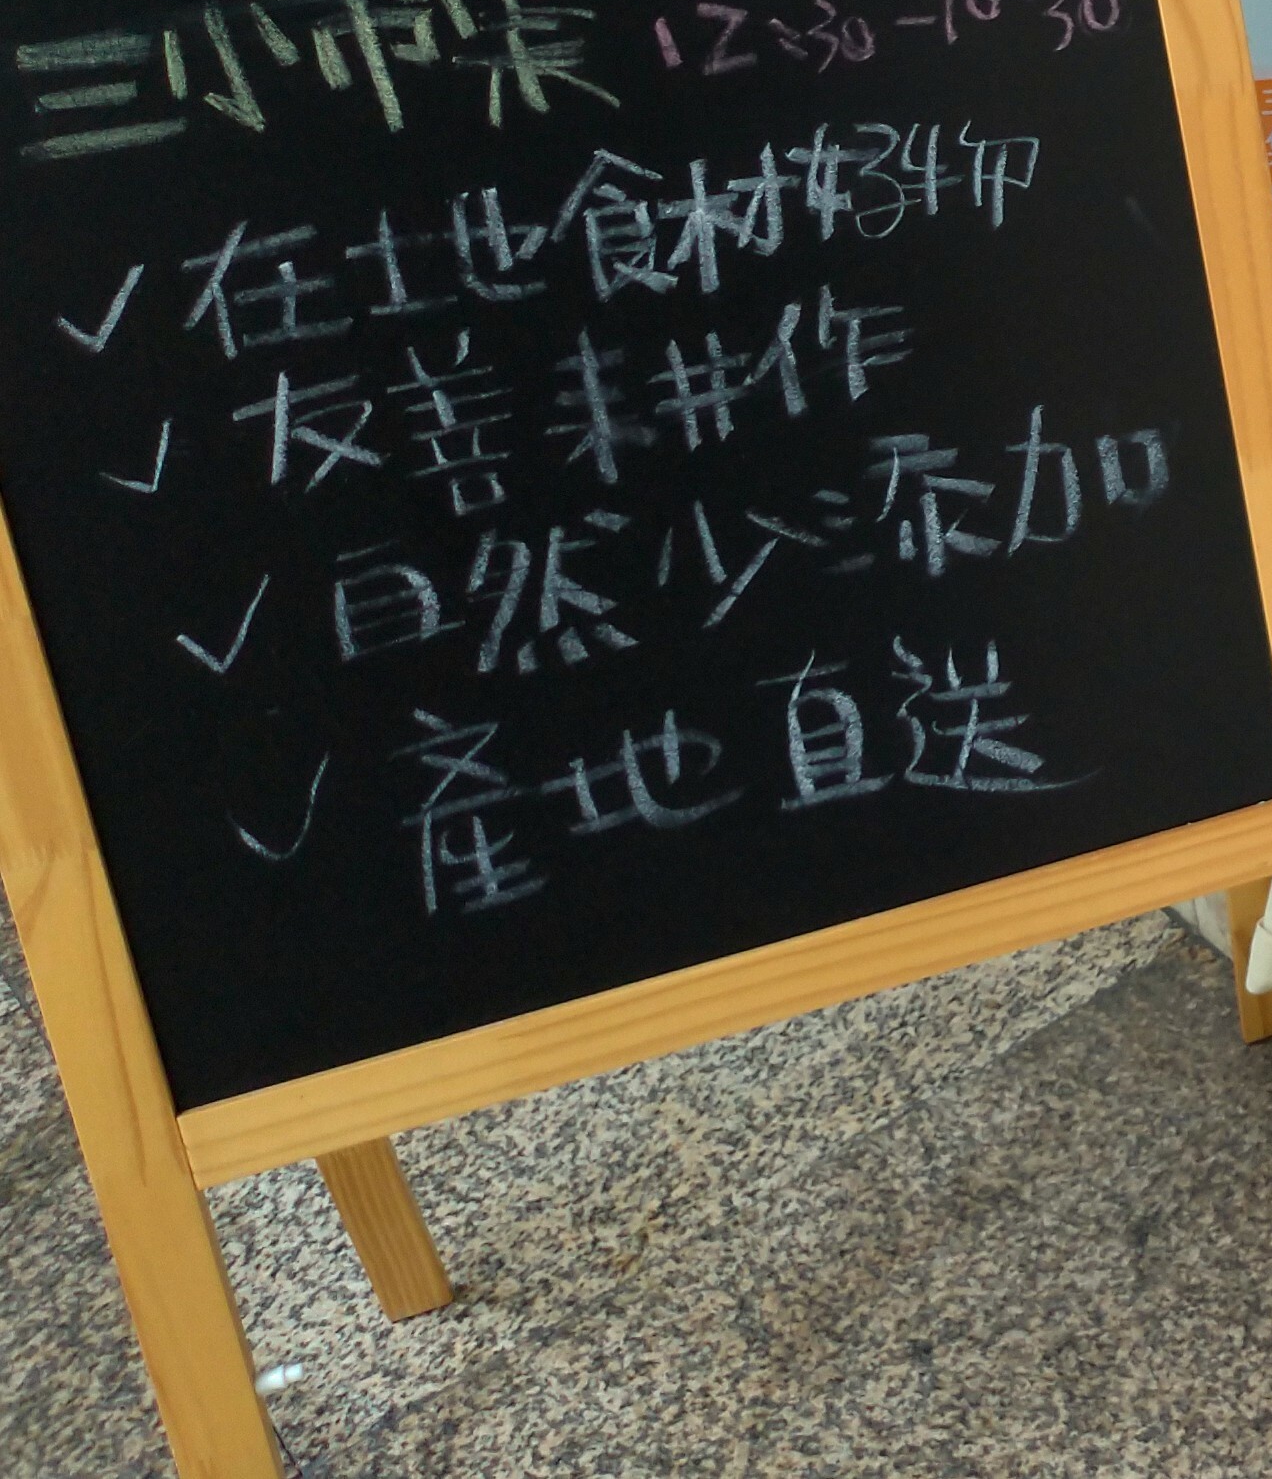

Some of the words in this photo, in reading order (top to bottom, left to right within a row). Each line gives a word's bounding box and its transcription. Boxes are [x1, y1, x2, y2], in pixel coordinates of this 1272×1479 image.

[232, 284, 914, 517] 友善耕作
[334, 404, 1170, 675] 自然少添加
[395, 634, 1102, 914] 產地直送
